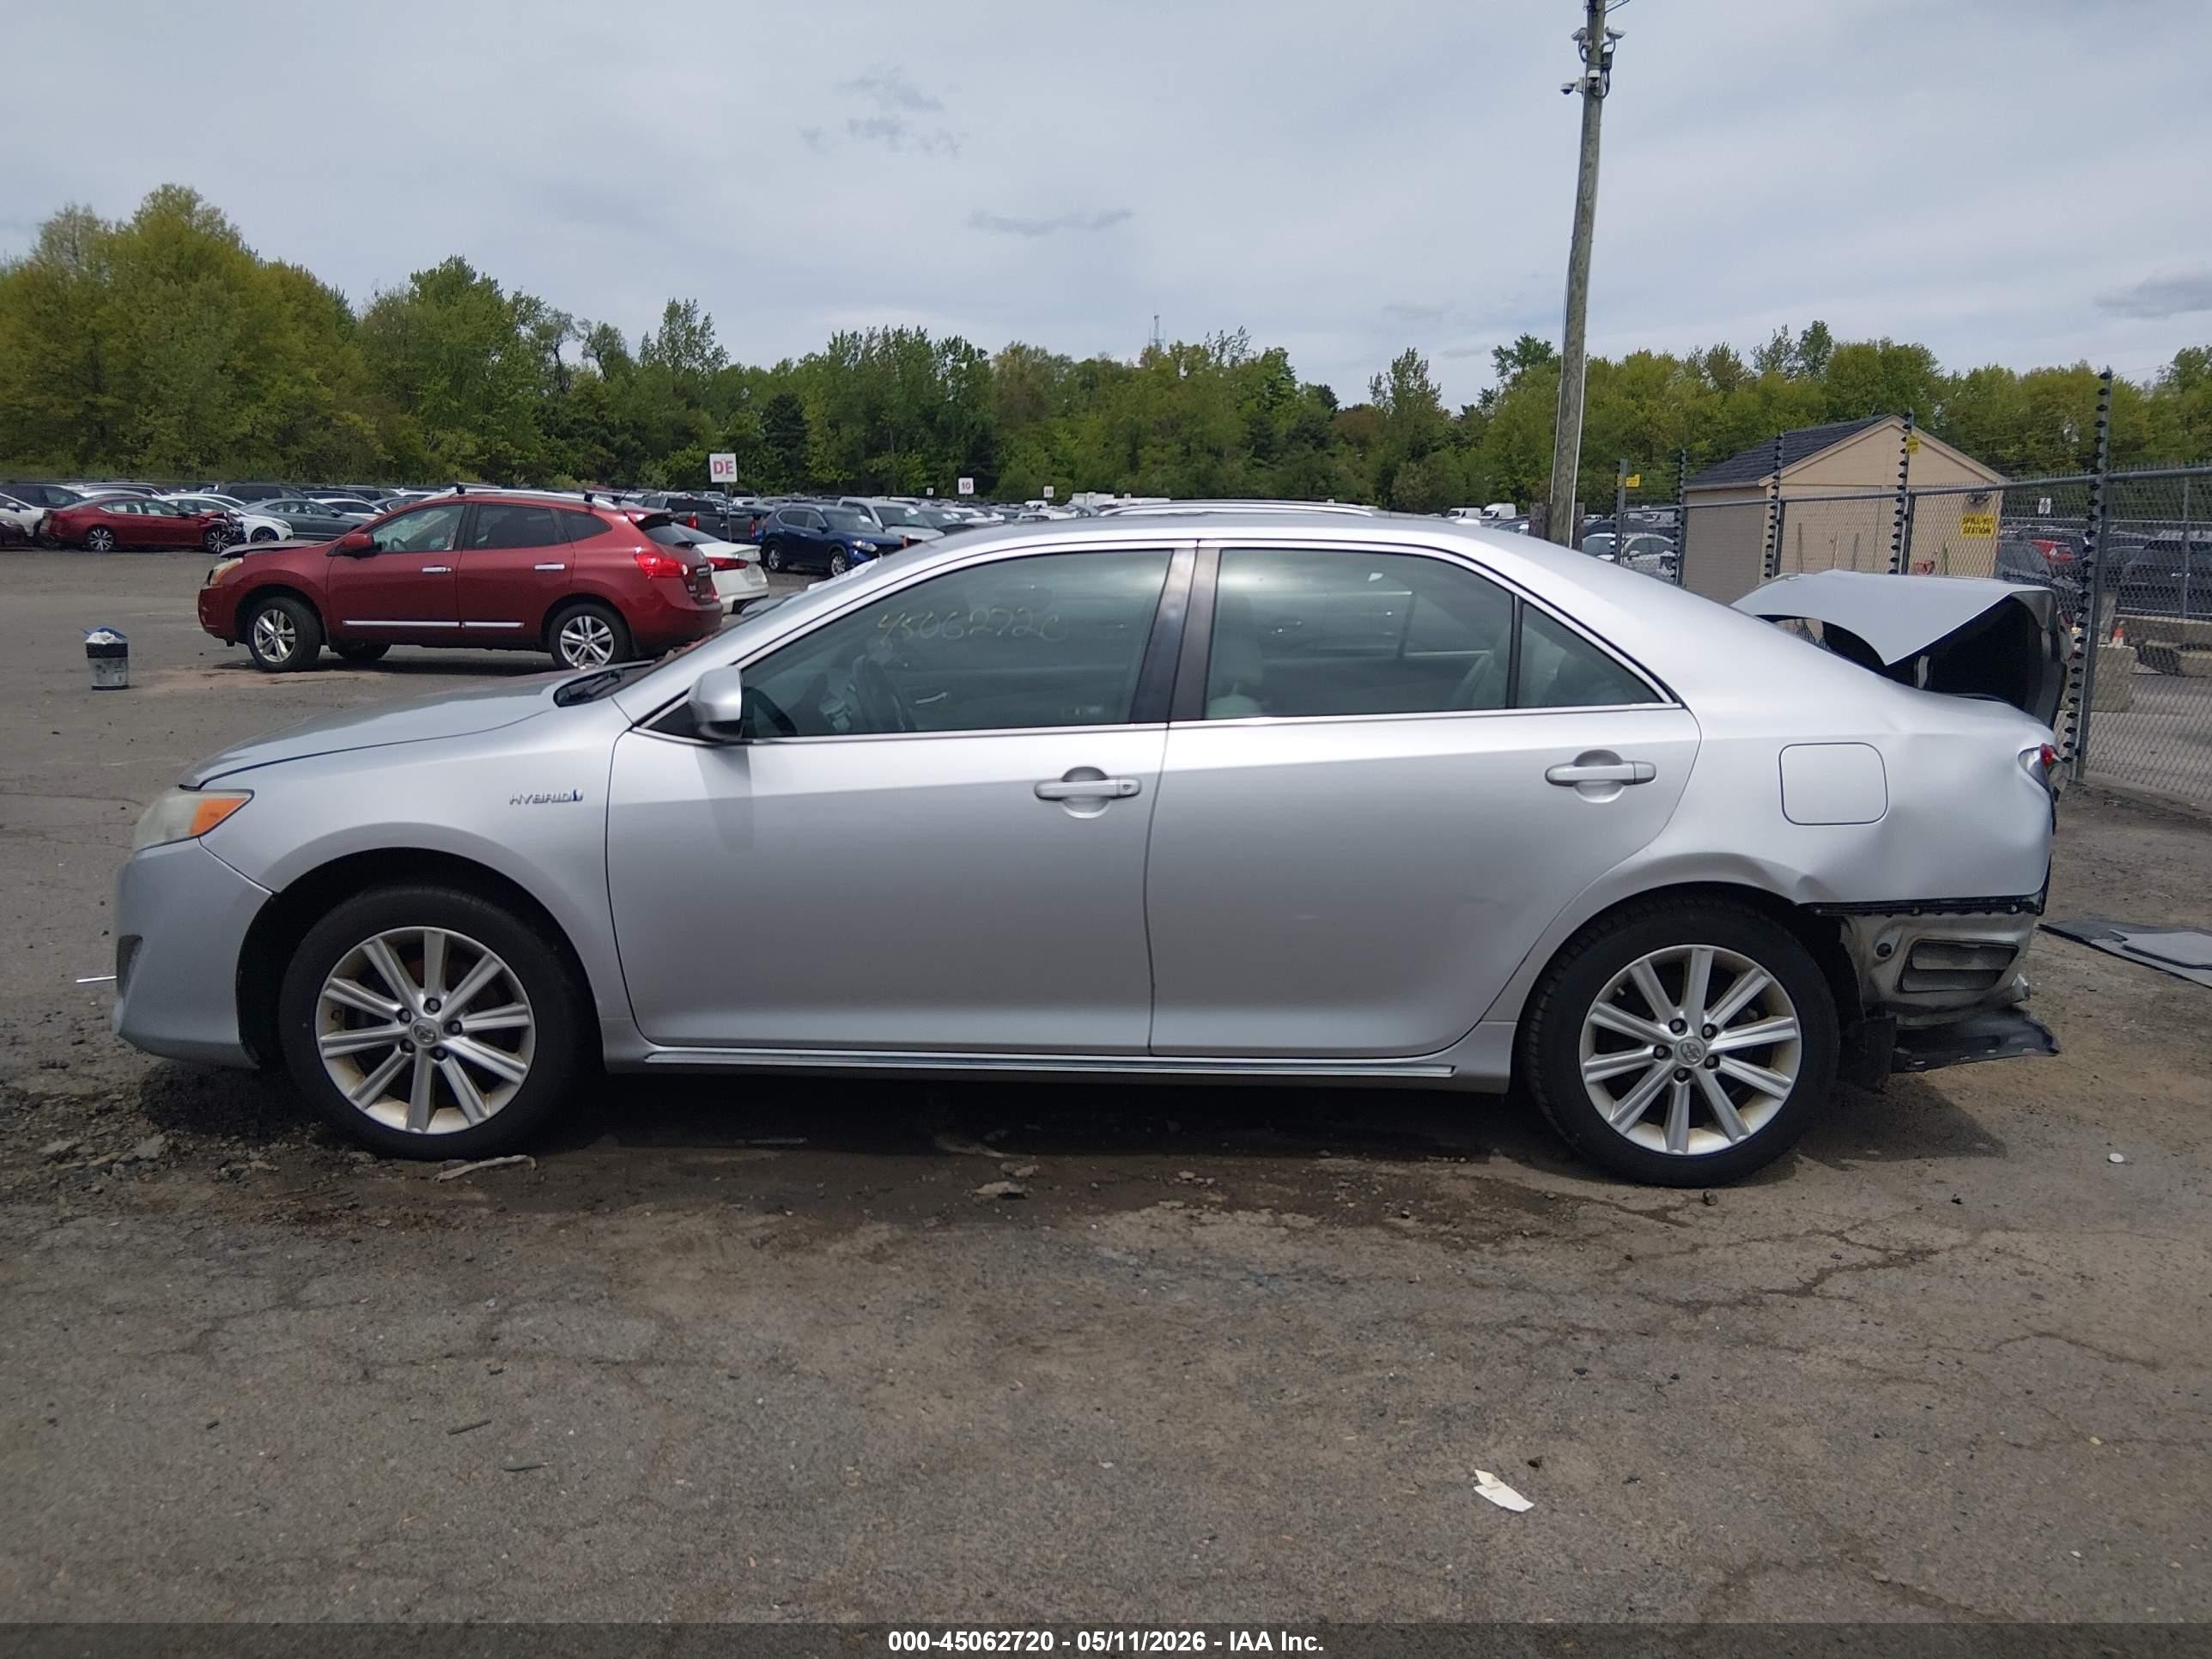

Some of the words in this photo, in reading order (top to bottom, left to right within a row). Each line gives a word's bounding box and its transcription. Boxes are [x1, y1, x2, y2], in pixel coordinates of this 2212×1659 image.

[713, 460, 734, 475] DE
[961, 481, 971, 490] 10
[509, 793, 573, 805] HYBRID
